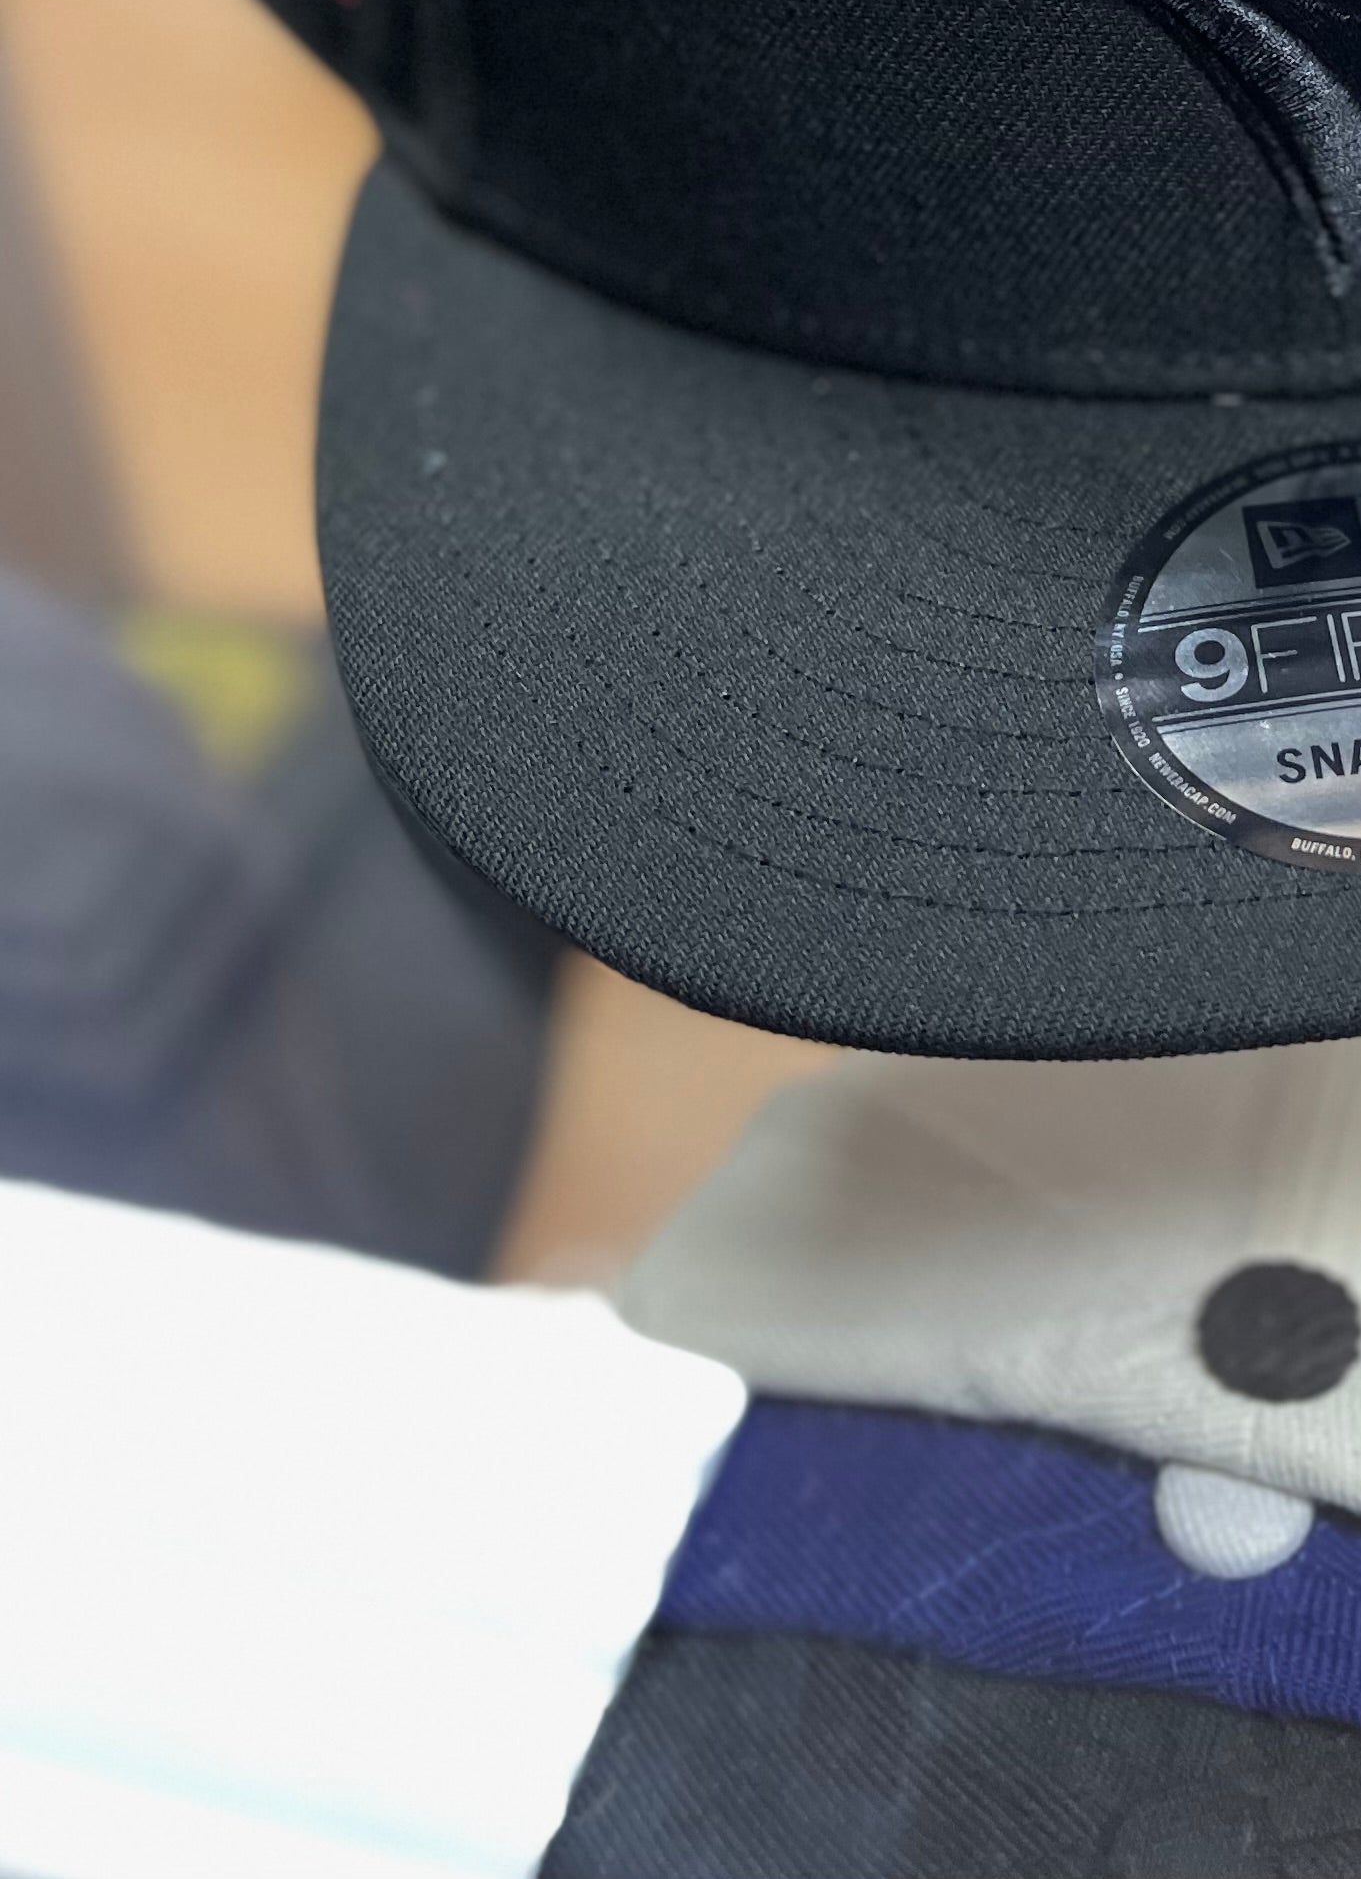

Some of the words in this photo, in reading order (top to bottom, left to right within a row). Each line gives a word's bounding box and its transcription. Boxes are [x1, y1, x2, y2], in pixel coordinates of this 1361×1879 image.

[1115, 686, 1136, 719] SINCE
[1149, 752, 1237, 825] NEWERACAP.COM
[1291, 837, 1356, 861] BUFFALO,
